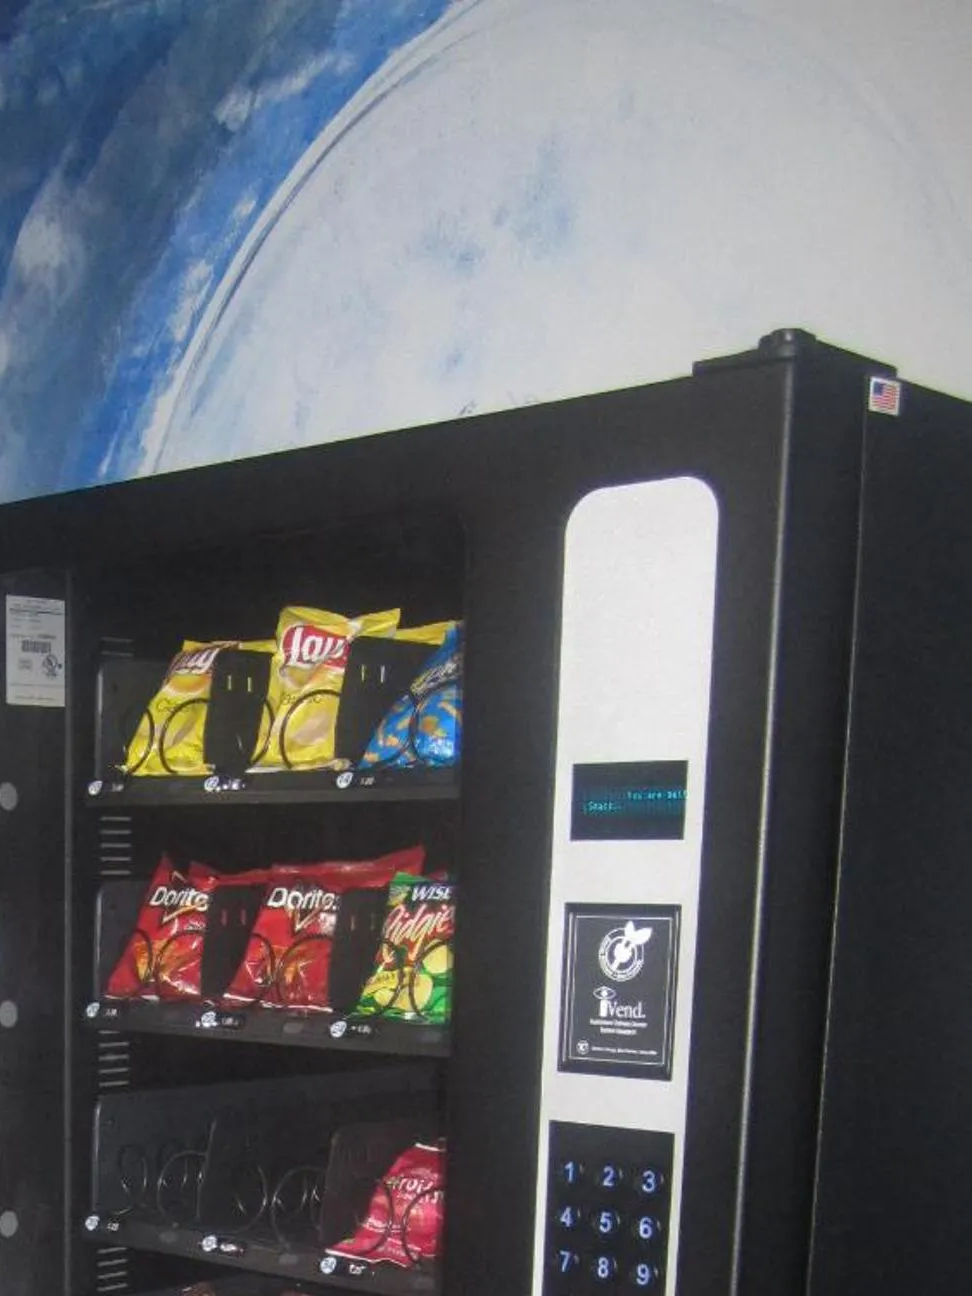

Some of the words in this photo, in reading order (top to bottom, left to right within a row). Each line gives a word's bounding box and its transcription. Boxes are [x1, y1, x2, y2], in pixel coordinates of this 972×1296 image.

[564, 1161, 575, 1183] 1
[602, 1166, 615, 1187] 2
[642, 1170, 655, 1192] 3
[560, 1206, 573, 1227] 4
[599, 1211, 612, 1233] 5
[639, 1217, 653, 1239] 6
[559, 1251, 572, 1273] 7
[597, 1257, 610, 1278] 8
[635, 1264, 650, 1286] 9
